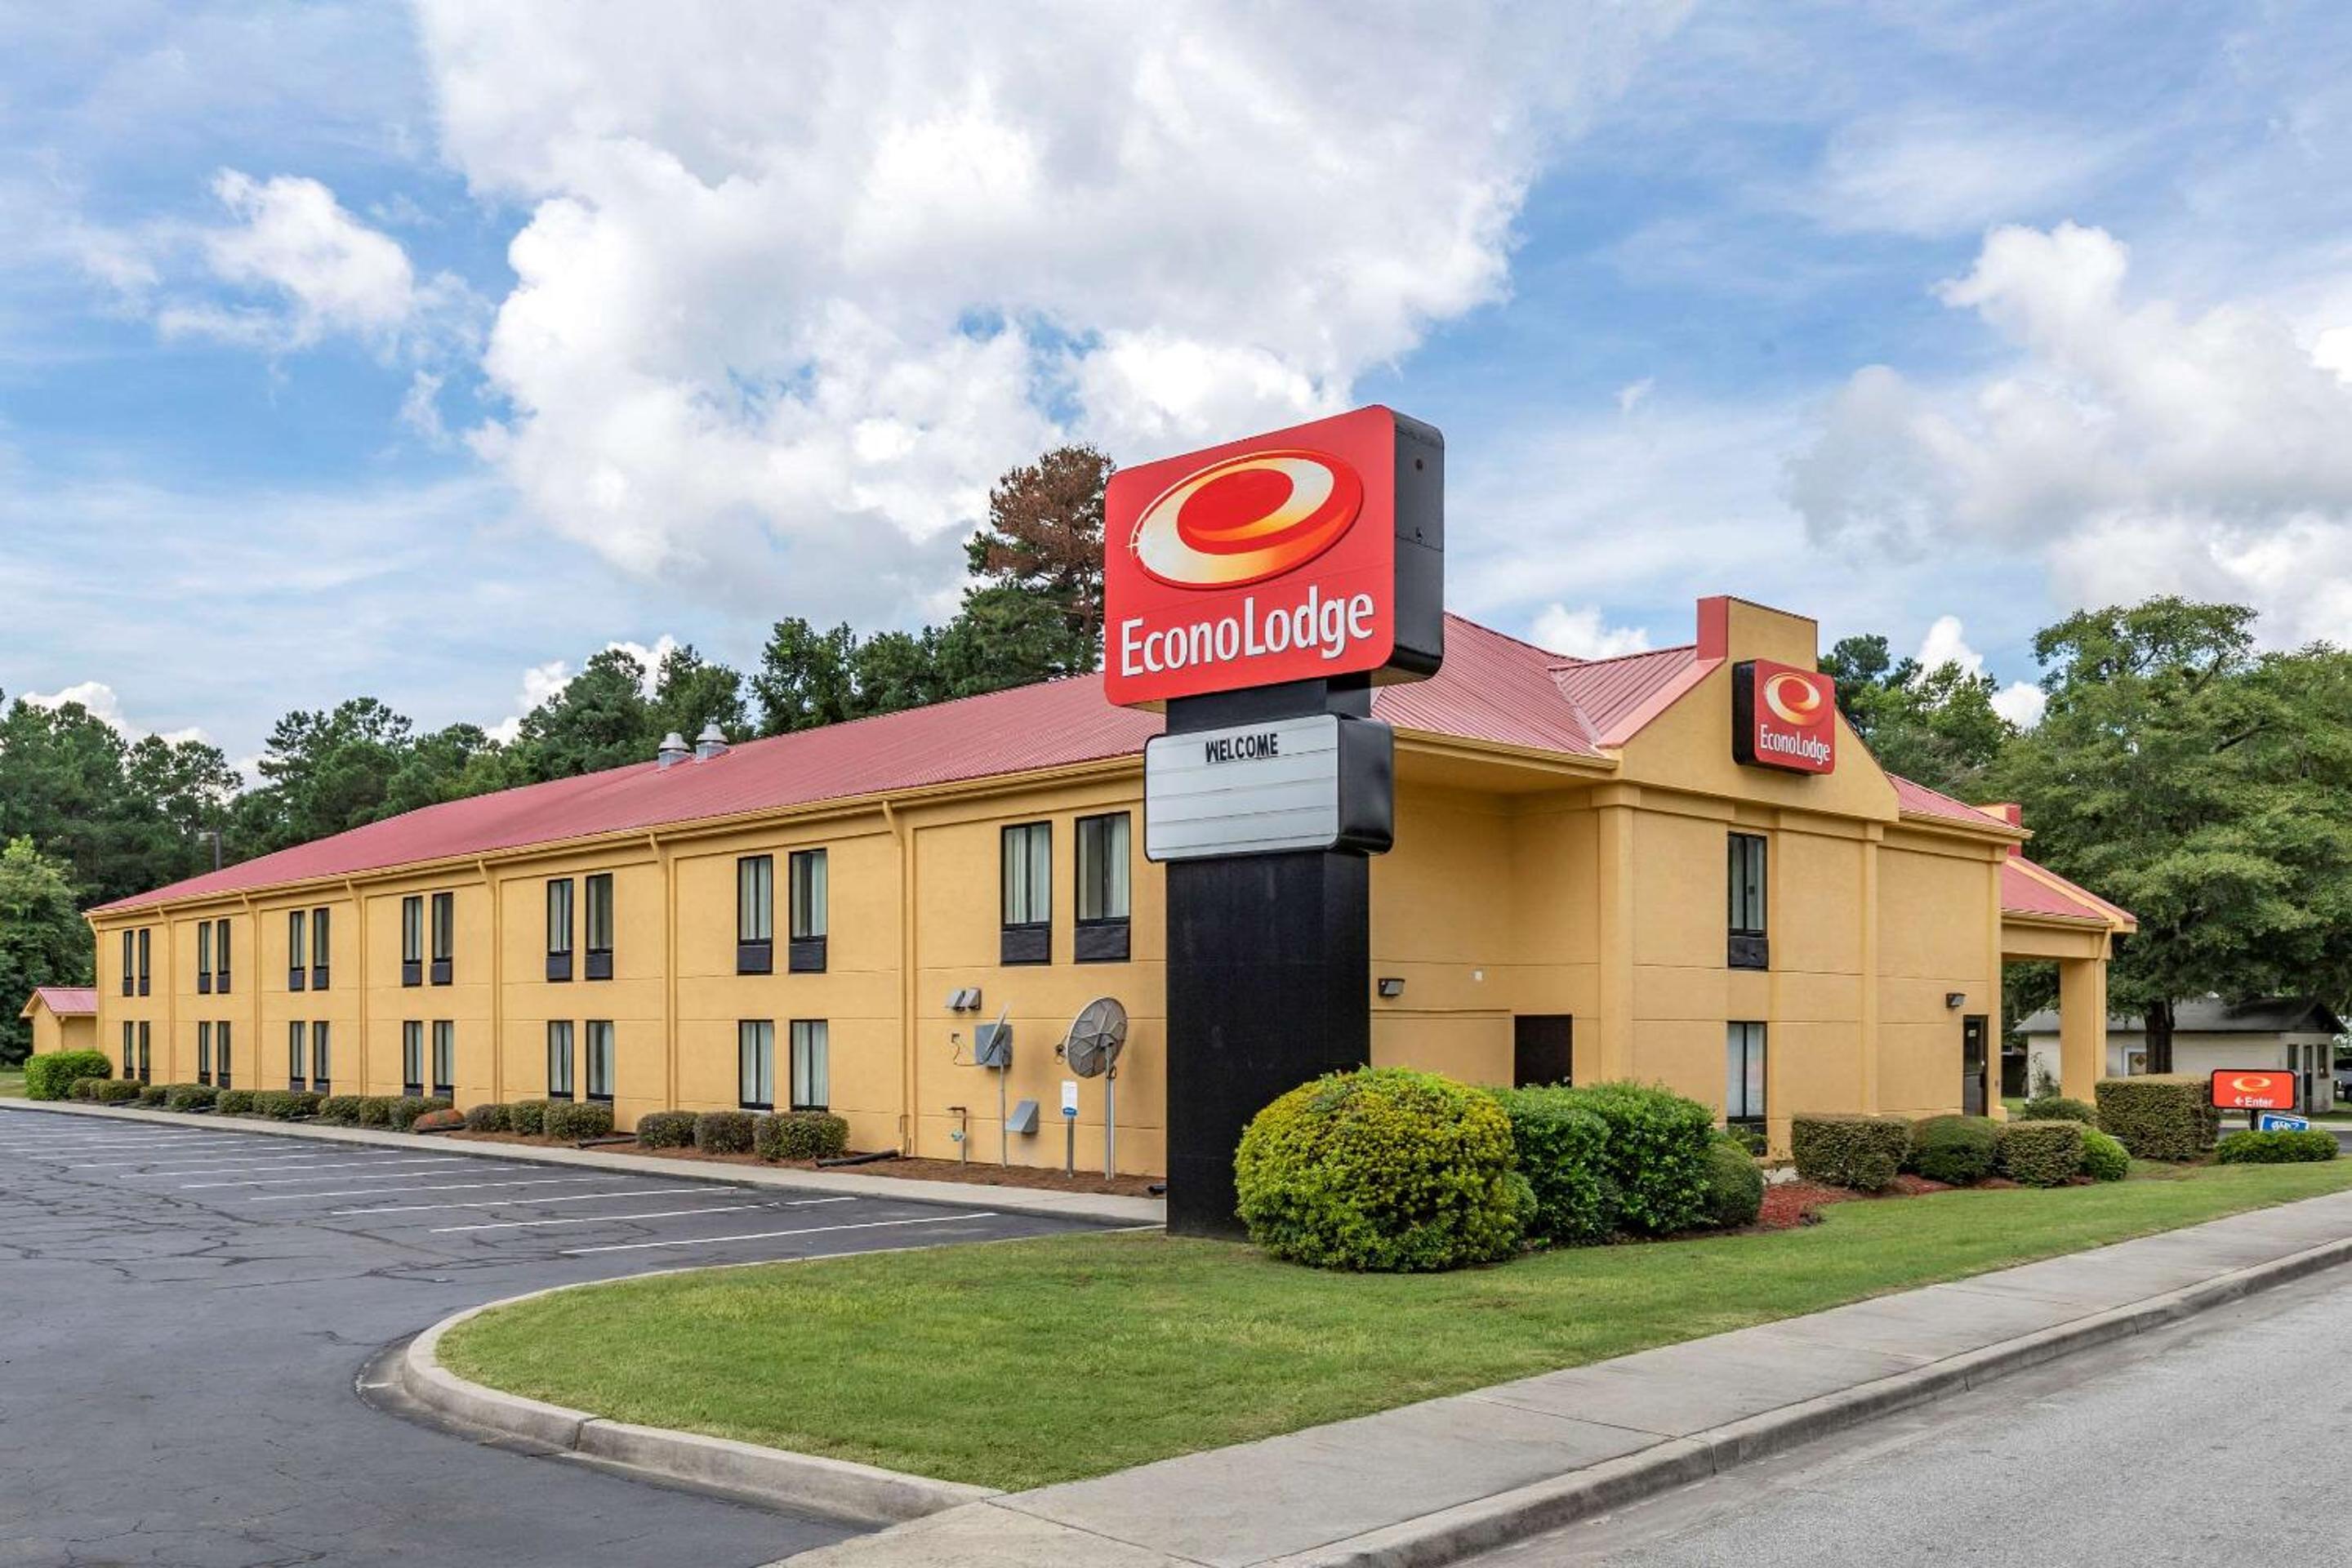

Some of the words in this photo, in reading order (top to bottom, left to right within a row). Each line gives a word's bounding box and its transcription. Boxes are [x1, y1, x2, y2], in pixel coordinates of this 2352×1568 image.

[1121, 586, 1374, 677] EconoLodge
[1205, 733, 1278, 762] WELCOME
[1761, 724, 1830, 764] EconoLodge
[2245, 1097, 2274, 1107] Enter
